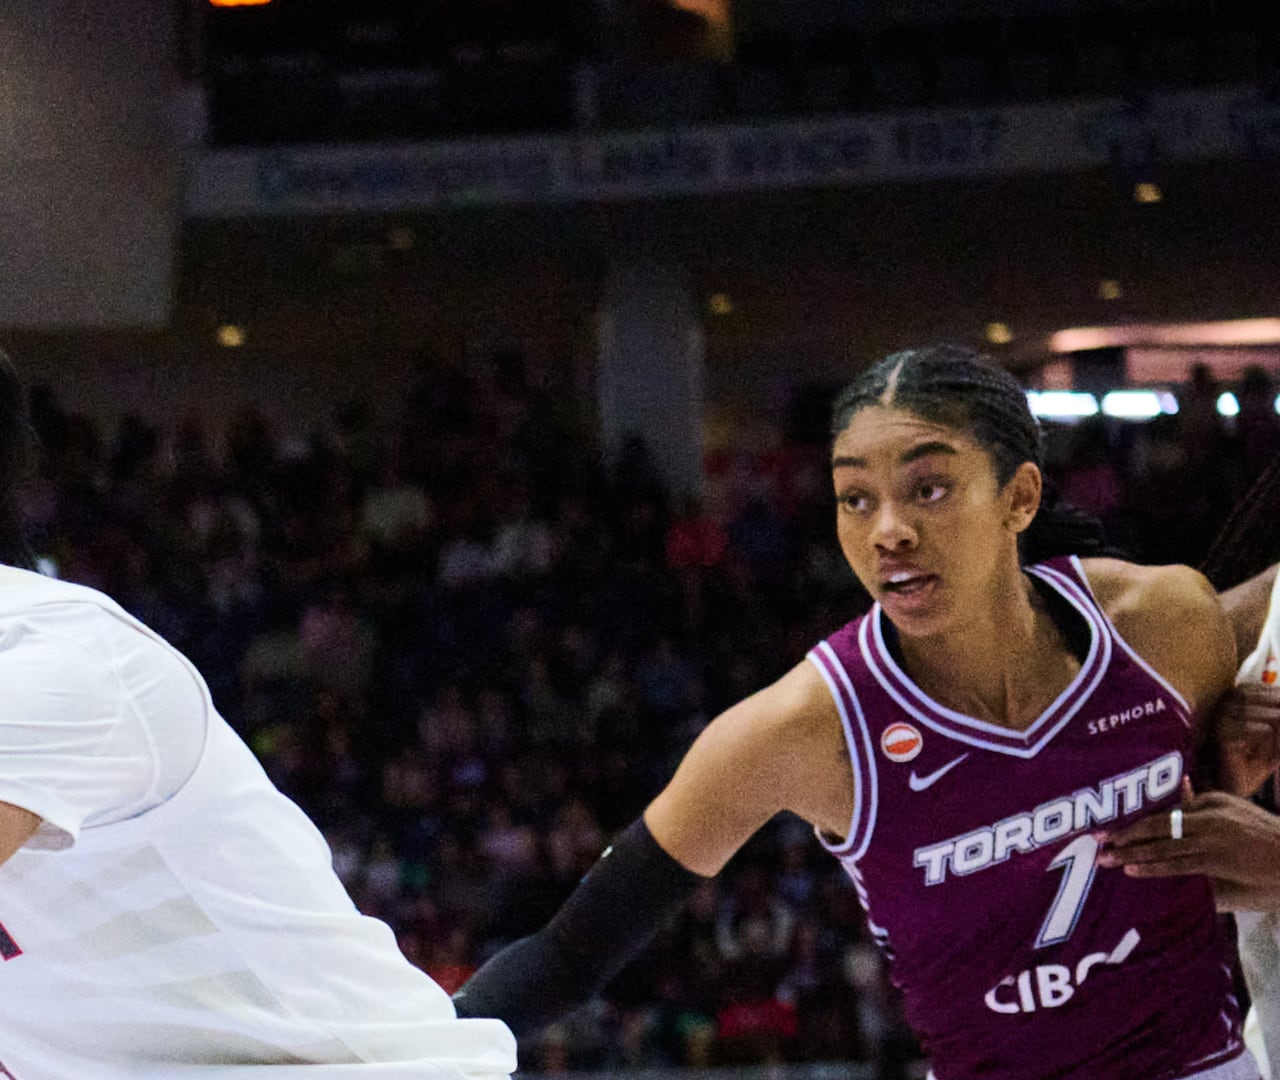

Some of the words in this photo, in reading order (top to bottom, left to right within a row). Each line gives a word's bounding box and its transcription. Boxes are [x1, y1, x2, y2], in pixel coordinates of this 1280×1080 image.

[1087, 697, 1166, 735] SEPHORA
[913, 751, 1184, 887] TORONTO
[1034, 833, 1102, 950] 1
